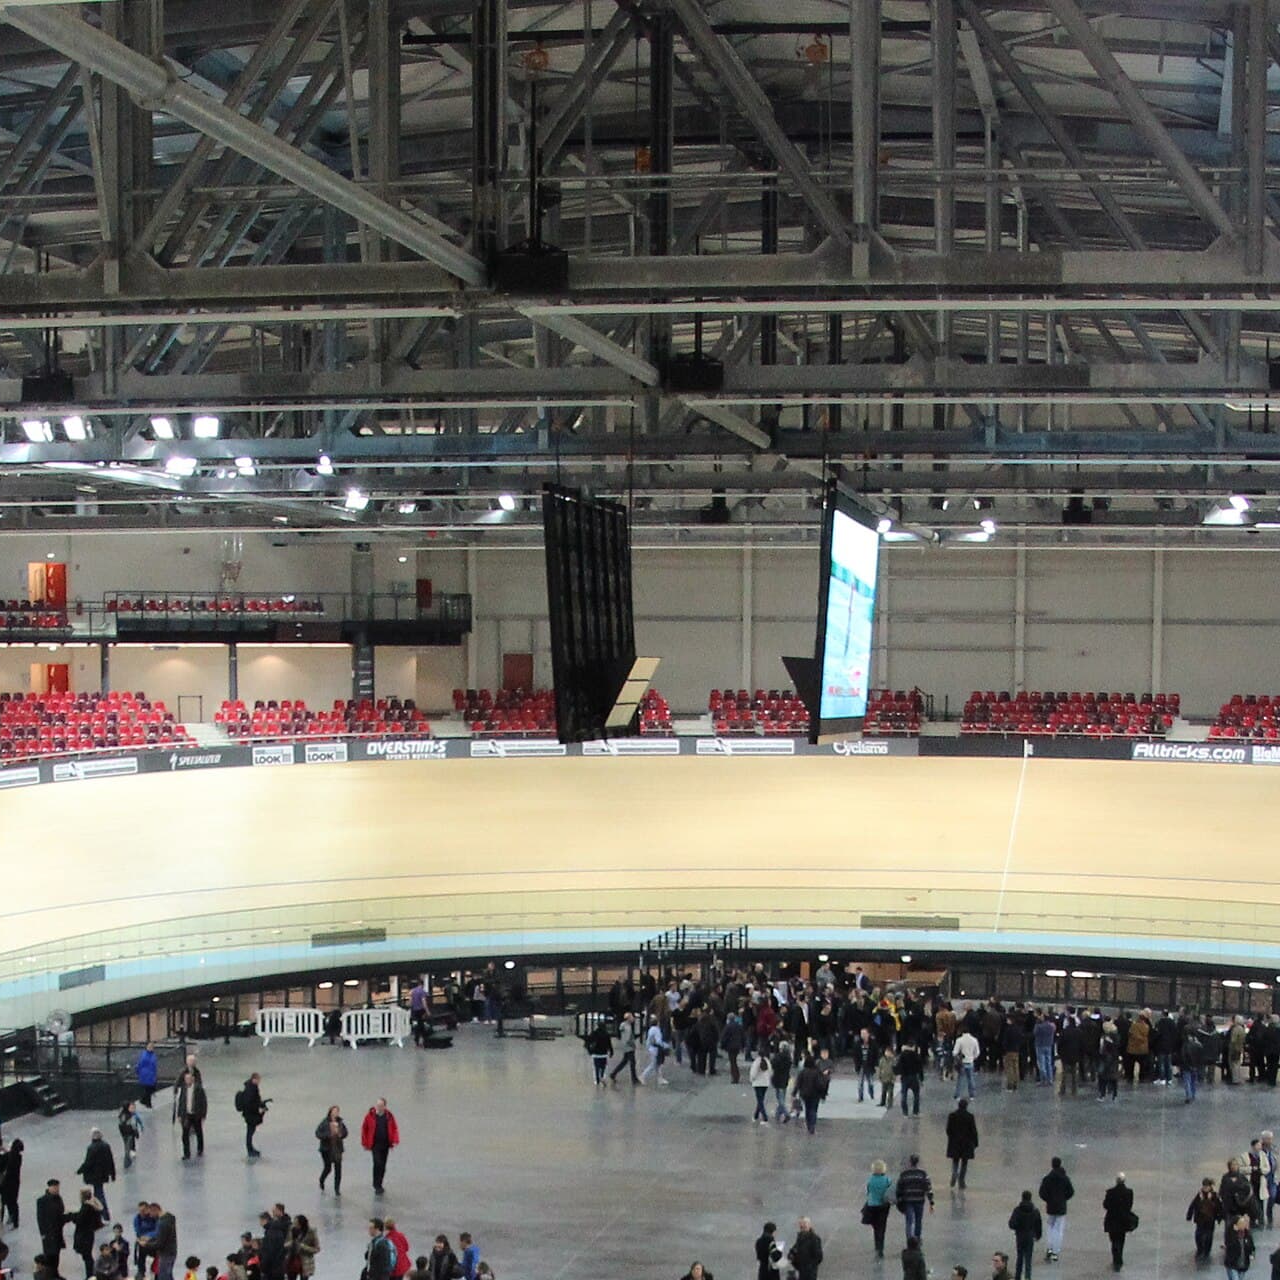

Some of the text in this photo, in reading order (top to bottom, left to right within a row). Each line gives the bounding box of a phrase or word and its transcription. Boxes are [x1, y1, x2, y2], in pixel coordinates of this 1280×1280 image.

[1133, 743, 1246, 760] Alltricks.com
[255, 755, 281, 765] LOOK
[307, 753, 333, 763] LOOK
